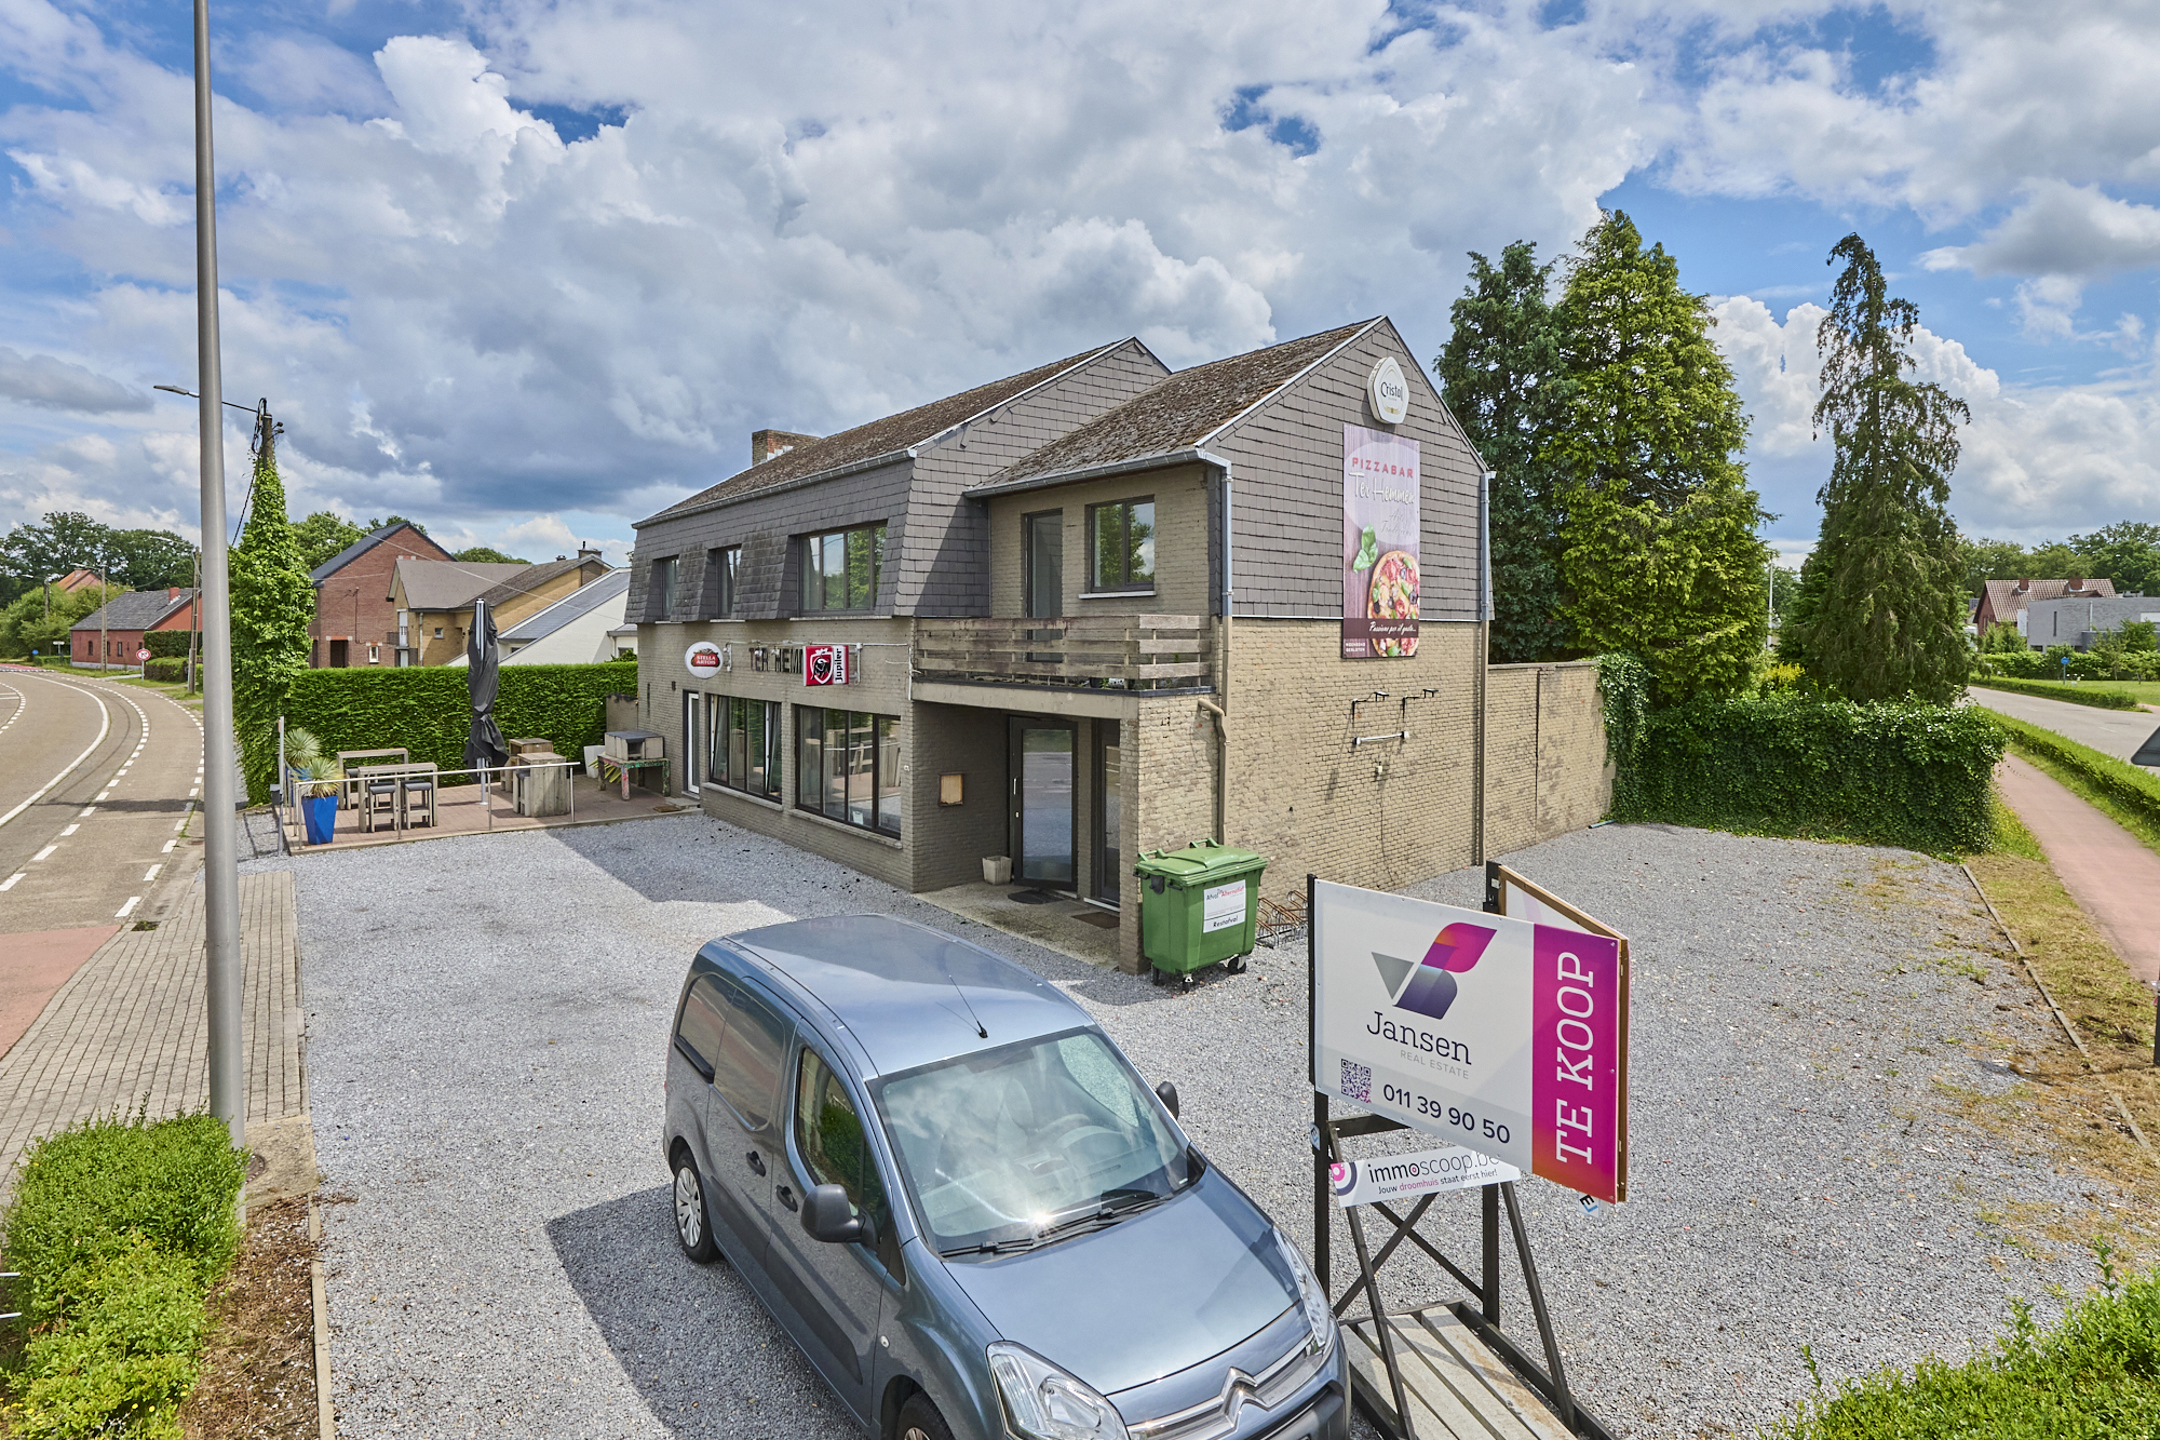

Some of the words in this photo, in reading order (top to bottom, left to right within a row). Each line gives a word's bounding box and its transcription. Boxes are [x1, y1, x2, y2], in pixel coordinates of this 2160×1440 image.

[1380, 381, 1403, 401] Cristal
[1352, 457, 1414, 478] PIZZABAR
[1348, 471, 1370, 498] Ter
[1372, 476, 1415, 506] Hemmen
[834, 648, 844, 683] Jupiler
[1366, 1010, 1472, 1066] Jansen
[1556, 951, 1594, 1092] KOOP
[1400, 1050, 1426, 1066] REAL
[1429, 1060, 1470, 1080] ESTATE
[1383, 1084, 1411, 1109] 011
[1417, 1095, 1442, 1119] 39
[1448, 1107, 1475, 1131] 90
[1482, 1118, 1511, 1144] 50
[1556, 1097, 1593, 1165] TE
[1378, 1185, 1398, 1194] Jouw
[1399, 1177, 1439, 1191] droomhuis
[1440, 1174, 1459, 1186] staat
[1460, 1172, 1480, 1182] eerst
[1480, 1168, 1498, 1178] hier!
